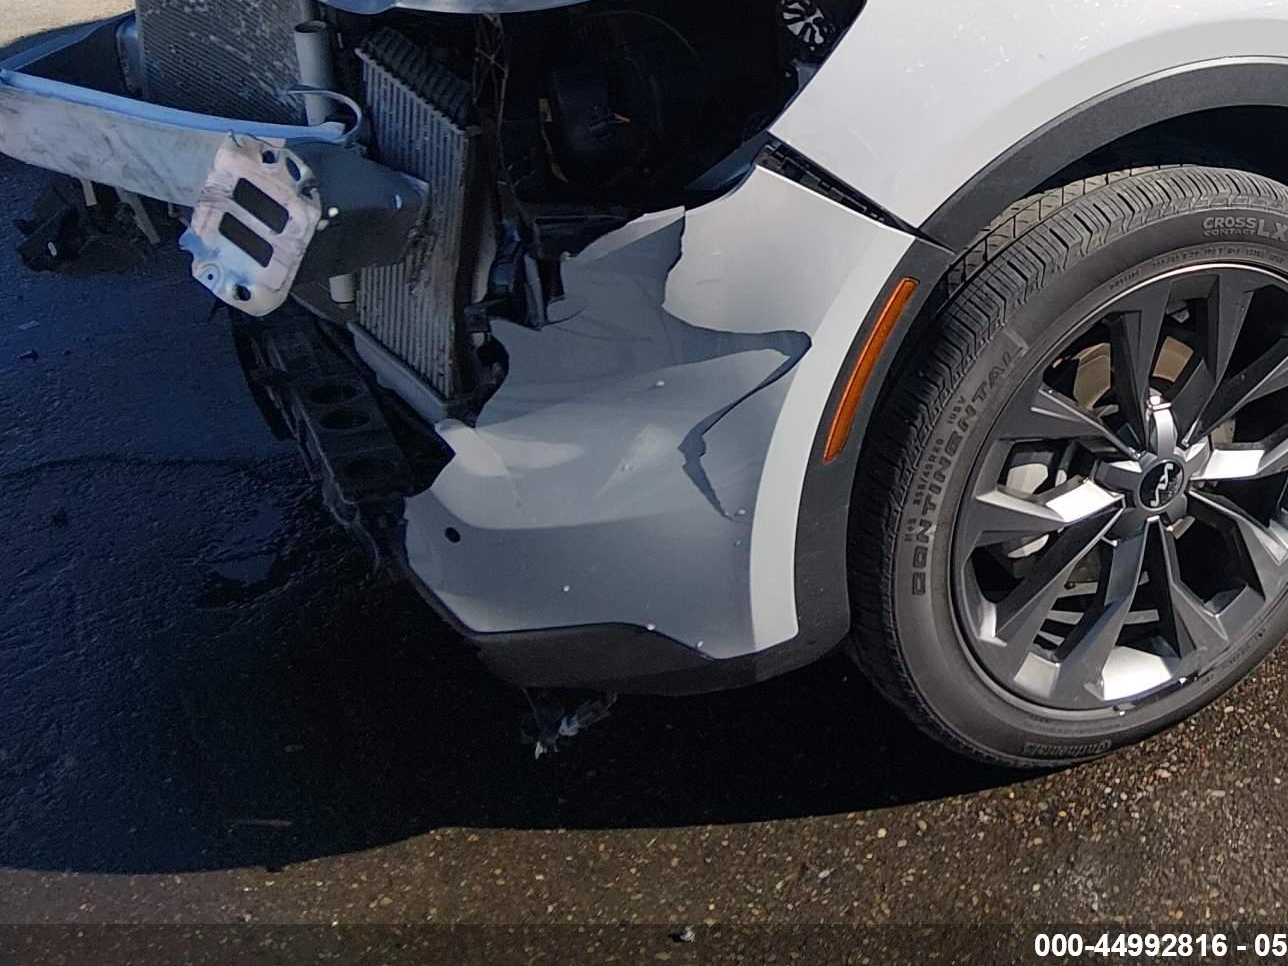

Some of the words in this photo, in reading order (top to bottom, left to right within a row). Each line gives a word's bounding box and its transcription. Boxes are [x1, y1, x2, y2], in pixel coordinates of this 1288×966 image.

[1203, 217, 1257, 229] CROSS
[1204, 228, 1257, 237] CONTACT
[1256, 219, 1288, 242] LX
